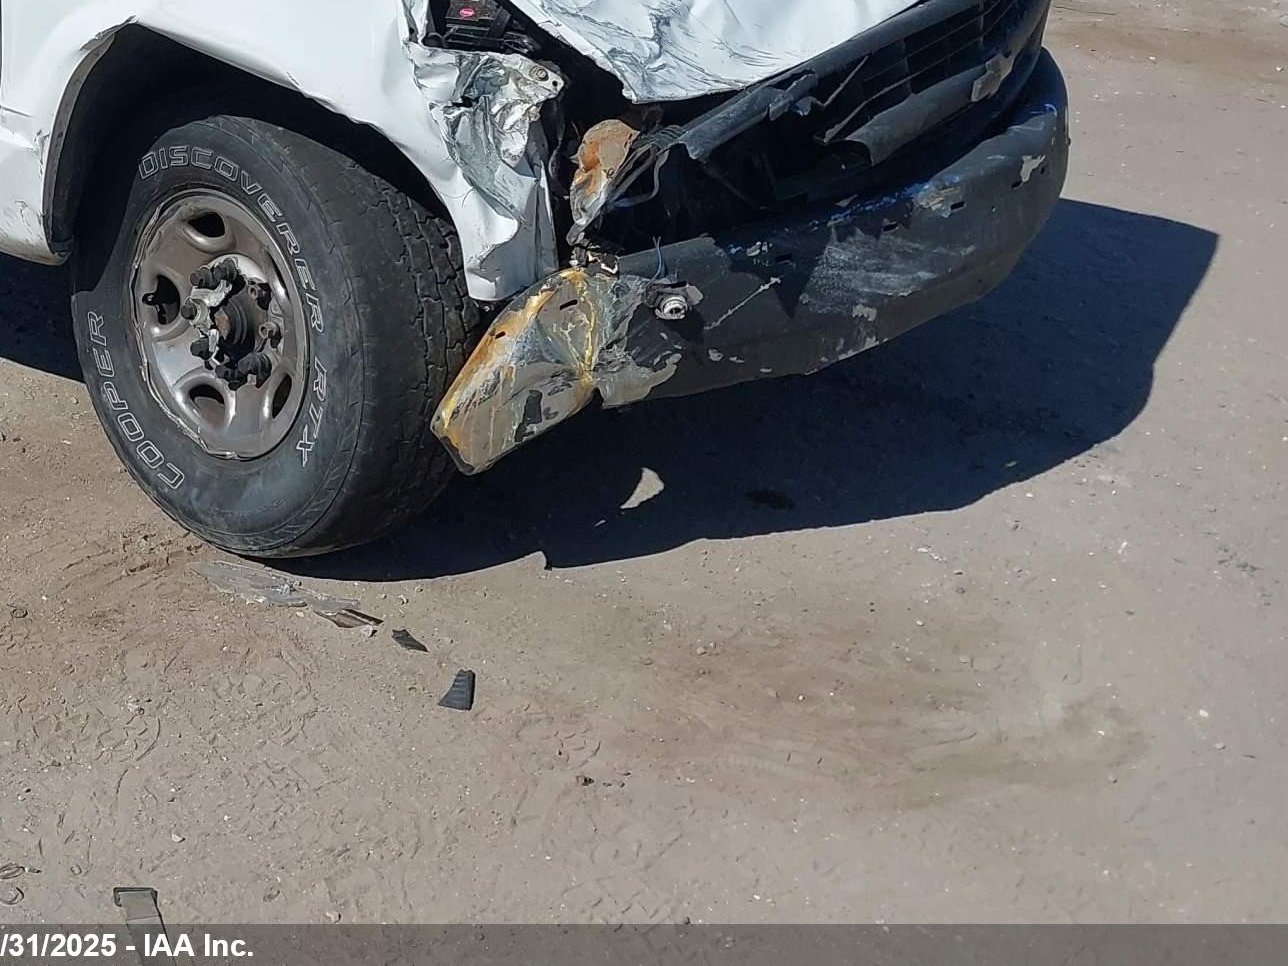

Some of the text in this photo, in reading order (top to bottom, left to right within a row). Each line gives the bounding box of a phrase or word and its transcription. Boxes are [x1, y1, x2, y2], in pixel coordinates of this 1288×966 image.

[87, 311, 185, 490] COOPER
[138, 145, 328, 468] DISCOVERER RTX
